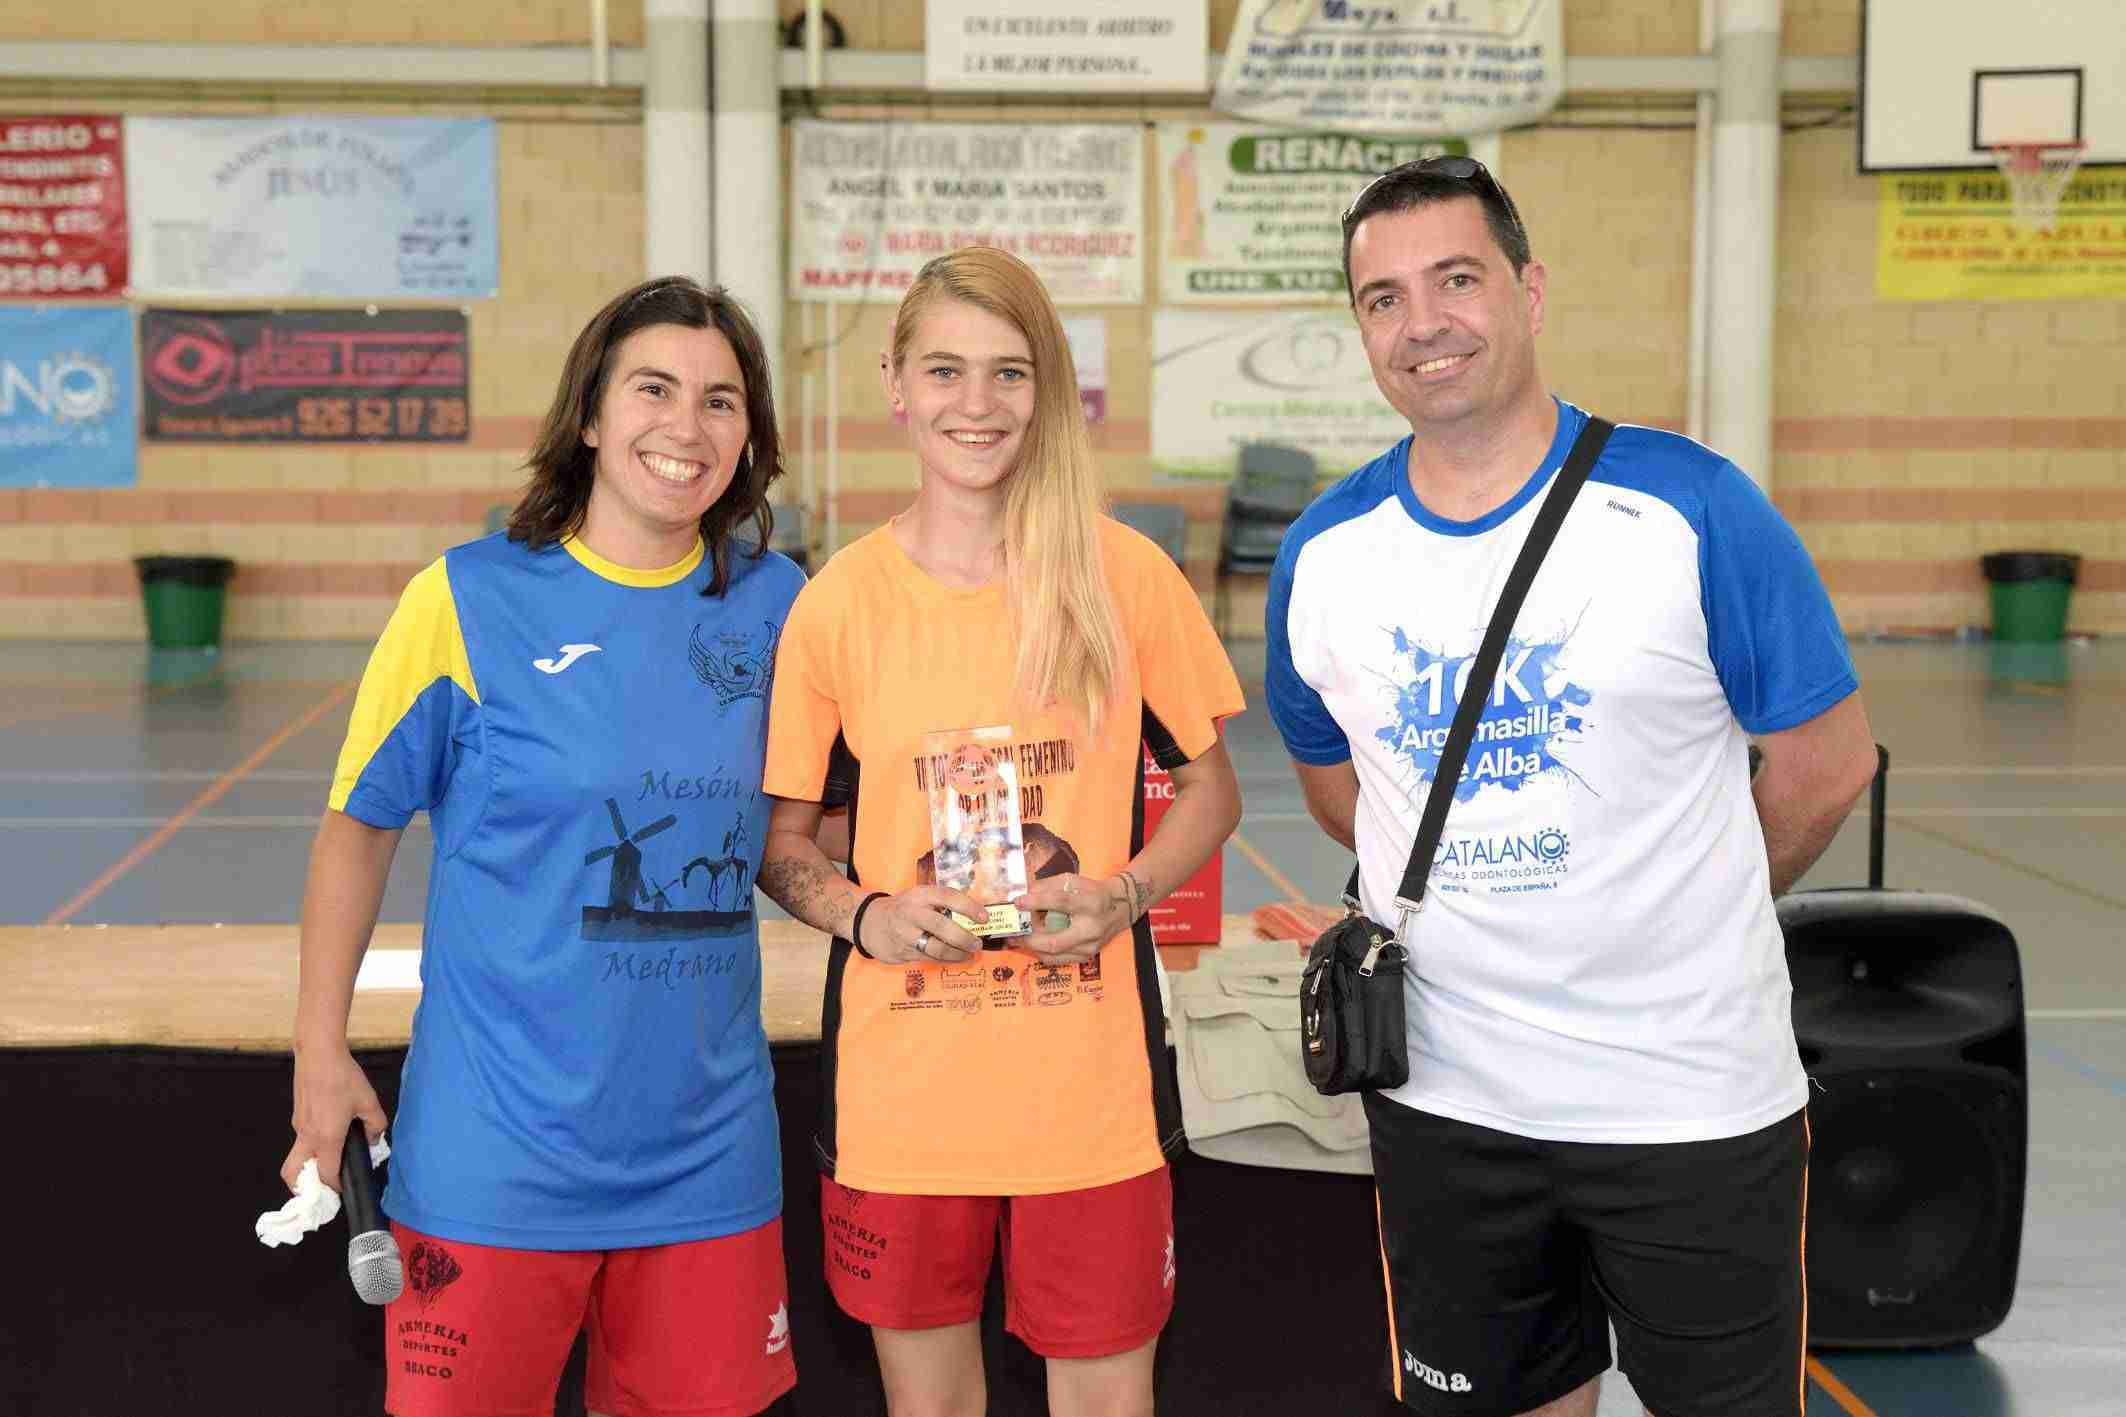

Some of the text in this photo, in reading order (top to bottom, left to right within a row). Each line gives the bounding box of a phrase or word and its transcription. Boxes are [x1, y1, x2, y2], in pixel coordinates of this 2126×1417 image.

[0, 124, 92, 150] ERIO
[0, 360, 113, 421] NO
[1400, 702, 1568, 757] Argmasilla
[1018, 739, 1075, 779] FEMENINO
[1472, 745, 1542, 780] Alba
